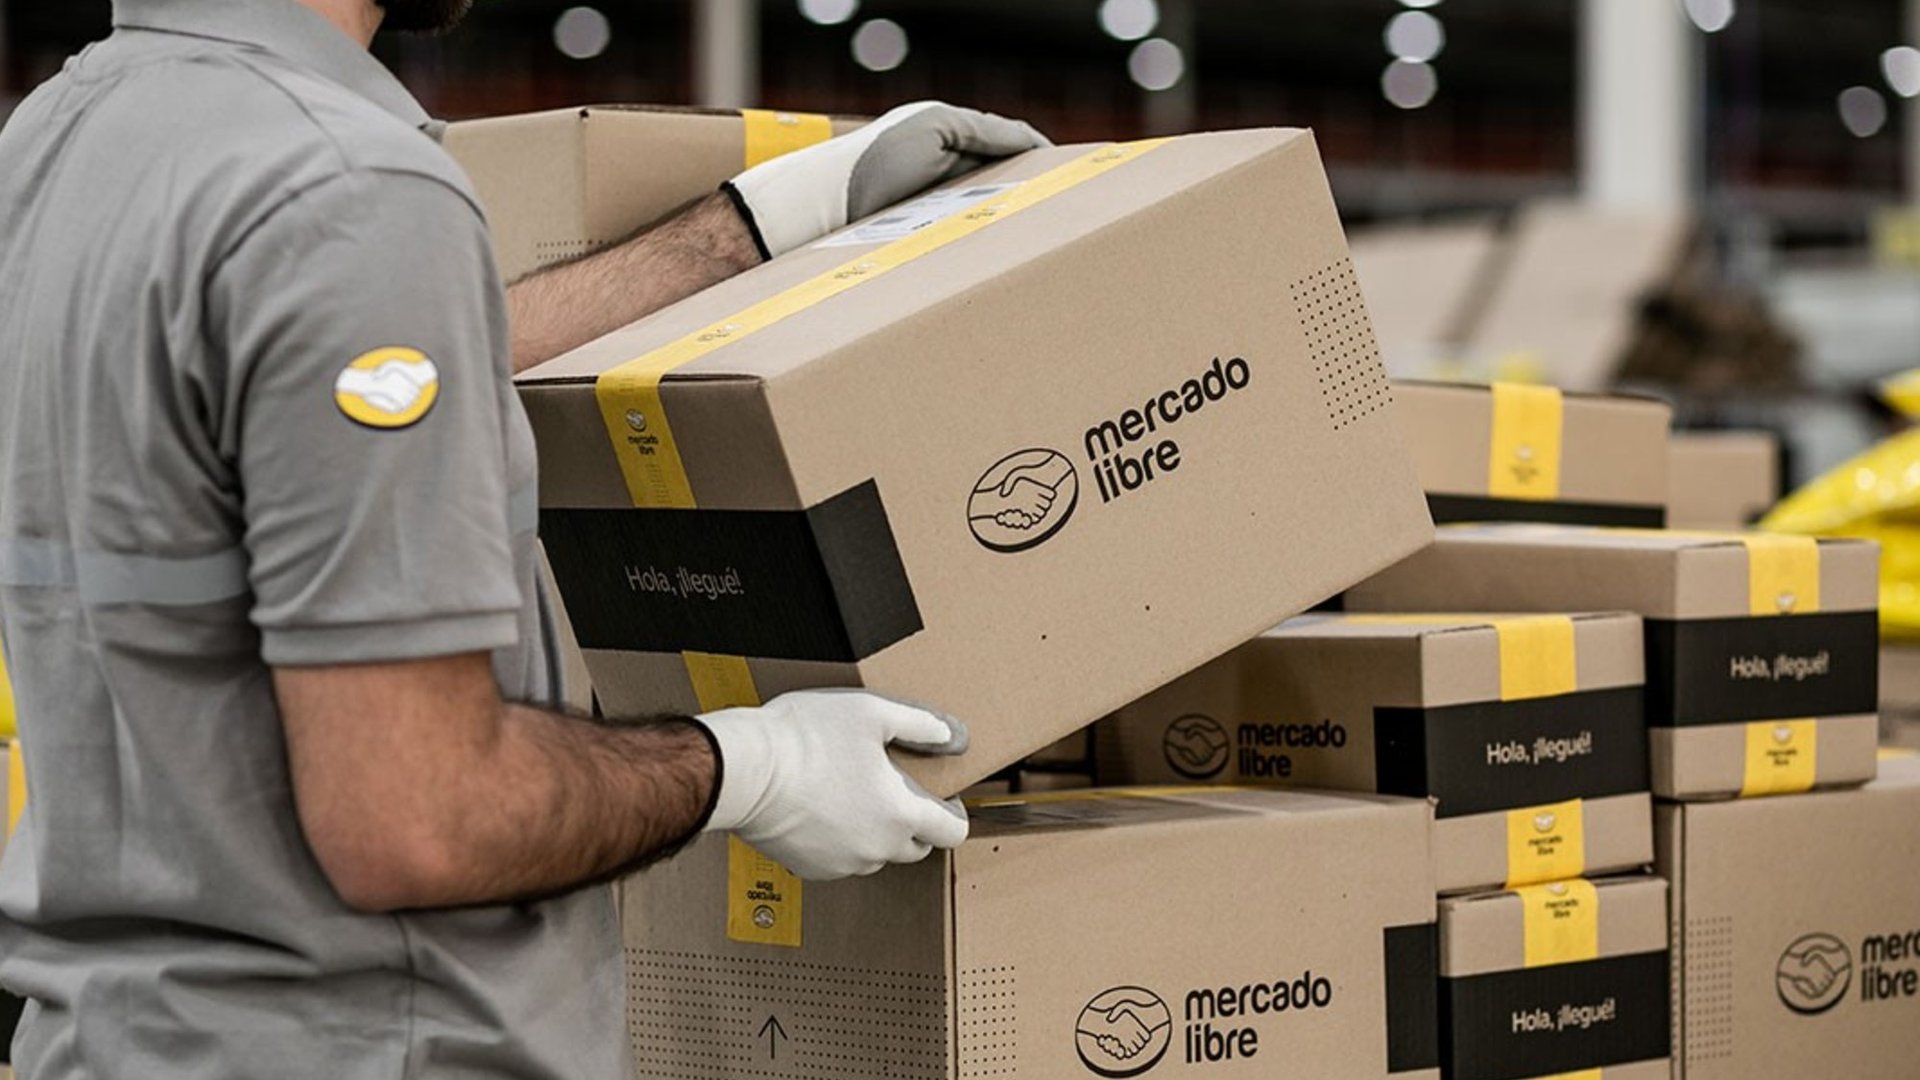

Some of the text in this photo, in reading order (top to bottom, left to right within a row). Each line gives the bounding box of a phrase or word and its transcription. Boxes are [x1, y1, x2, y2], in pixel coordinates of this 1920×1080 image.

[1084, 356, 1250, 461] mercado
[1093, 439, 1181, 503] libre
[625, 565, 745, 600] Hola, ¡llegué!
[1730, 654, 1771, 680] Hola,
[1236, 718, 1347, 748] mercado
[1237, 748, 1292, 777] libre
[1487, 740, 1531, 765] Hola,
[1185, 970, 1332, 1021] mercado
[1861, 965, 1918, 1002] libre
[1512, 1007, 1554, 1034] Hola,
[1186, 1023, 1258, 1064] libre
